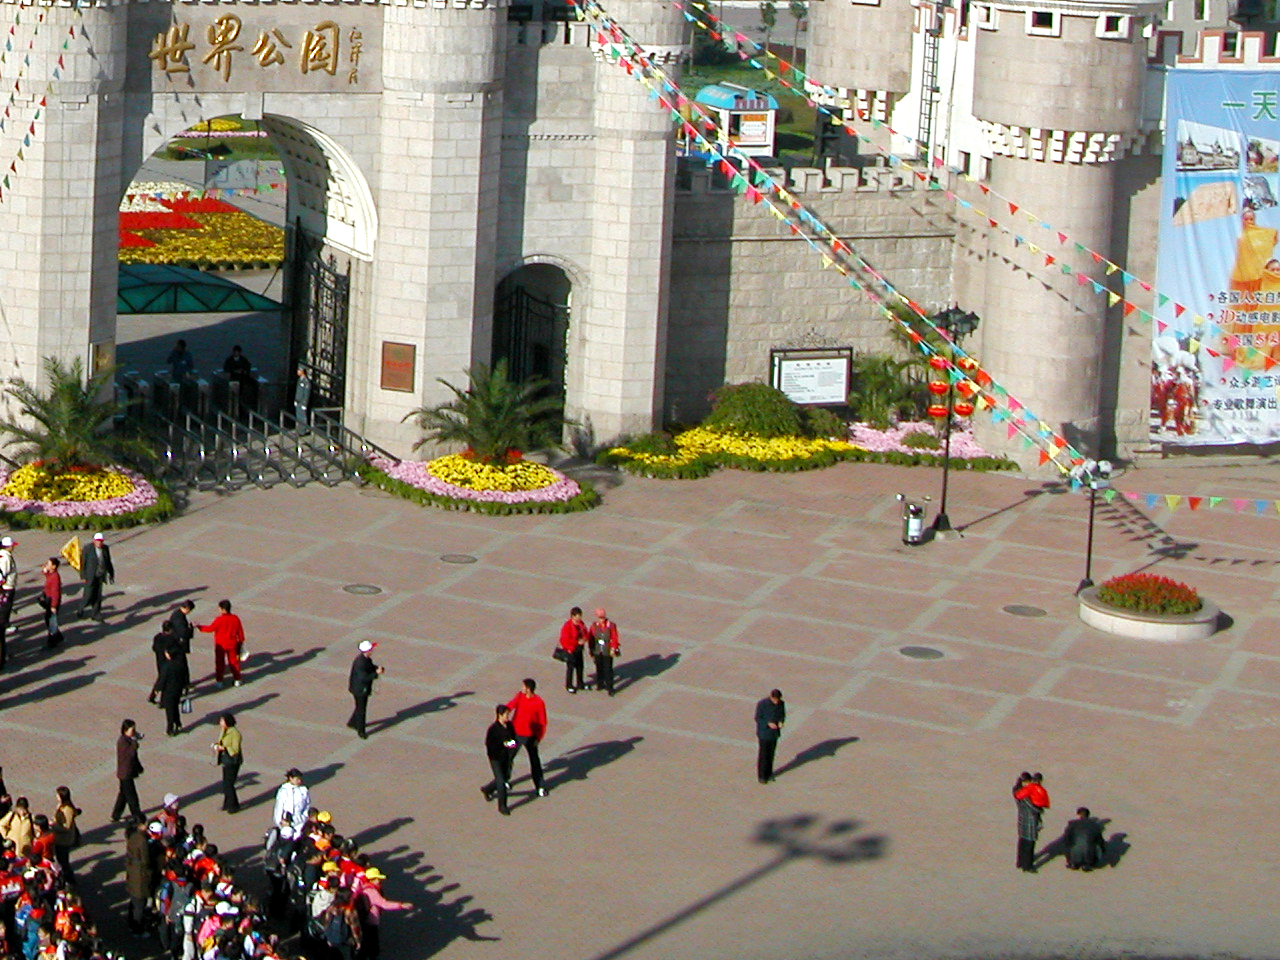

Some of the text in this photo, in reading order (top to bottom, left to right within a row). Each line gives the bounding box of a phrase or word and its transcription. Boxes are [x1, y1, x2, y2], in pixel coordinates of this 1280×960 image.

[148, 12, 339, 82] 世界公园
[1222, 92, 1277, 119] 一天
